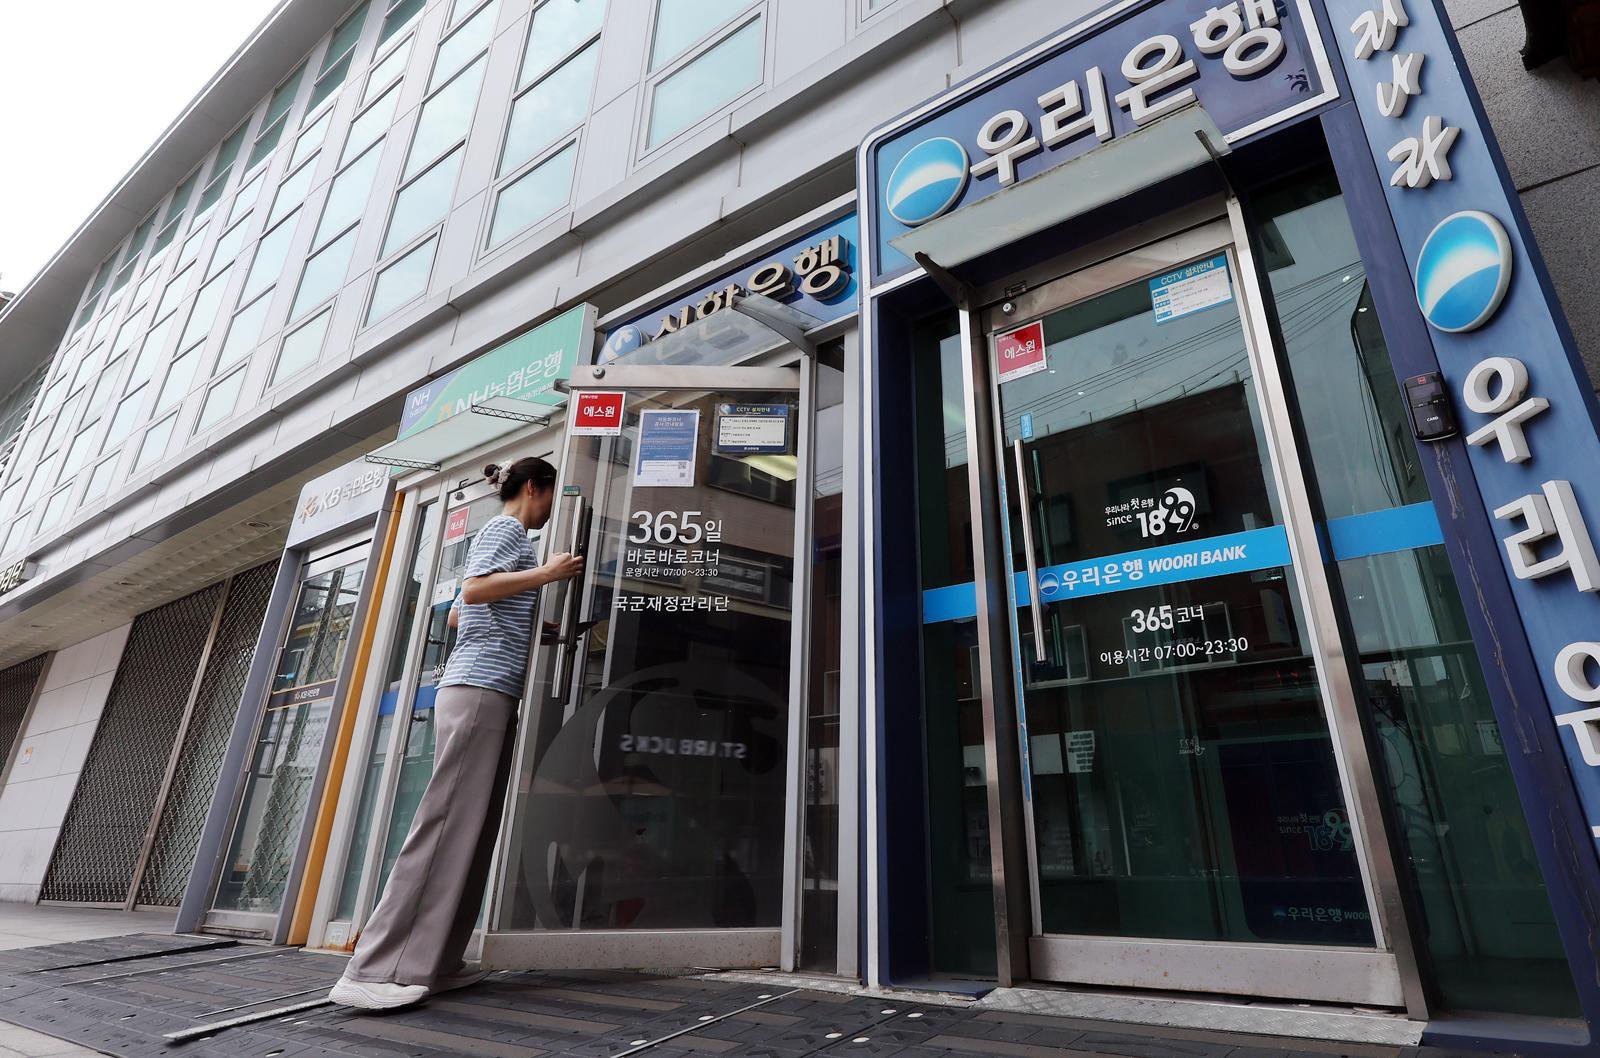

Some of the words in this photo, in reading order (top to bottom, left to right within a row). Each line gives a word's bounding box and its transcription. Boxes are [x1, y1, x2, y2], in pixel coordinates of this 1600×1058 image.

[970, 0, 1285, 186] 우리은행
[1160, 270, 1183, 285] CCTV
[1184, 259, 1215, 278] 설치안내
[1004, 339, 1036, 360] 에스원
[411, 389, 431, 409] NH
[583, 405, 615, 418] 에스원
[1105, 502, 1130, 515] 우리나라
[1130, 498, 1140, 510] 첫
[1140, 497, 1154, 509] 은행
[1106, 512, 1133, 527] since
[1136, 487, 1196, 538] 1899
[626, 549, 720, 566] 바로바로코너
[1061, 558, 1143, 591] 우리은행
[1148, 552, 1198, 574] WOORI
[1200, 544, 1247, 566] BANK
[625, 567, 660, 577] 운영시간
[663, 567, 719, 577] 07:00~23:30
[612, 595, 730, 613] 국군재정관리단
[1099, 645, 1151, 666] 이용시간
[1154, 636, 1249, 661] 07:00~23:30
[1287, 907, 1342, 922] 우리은행
